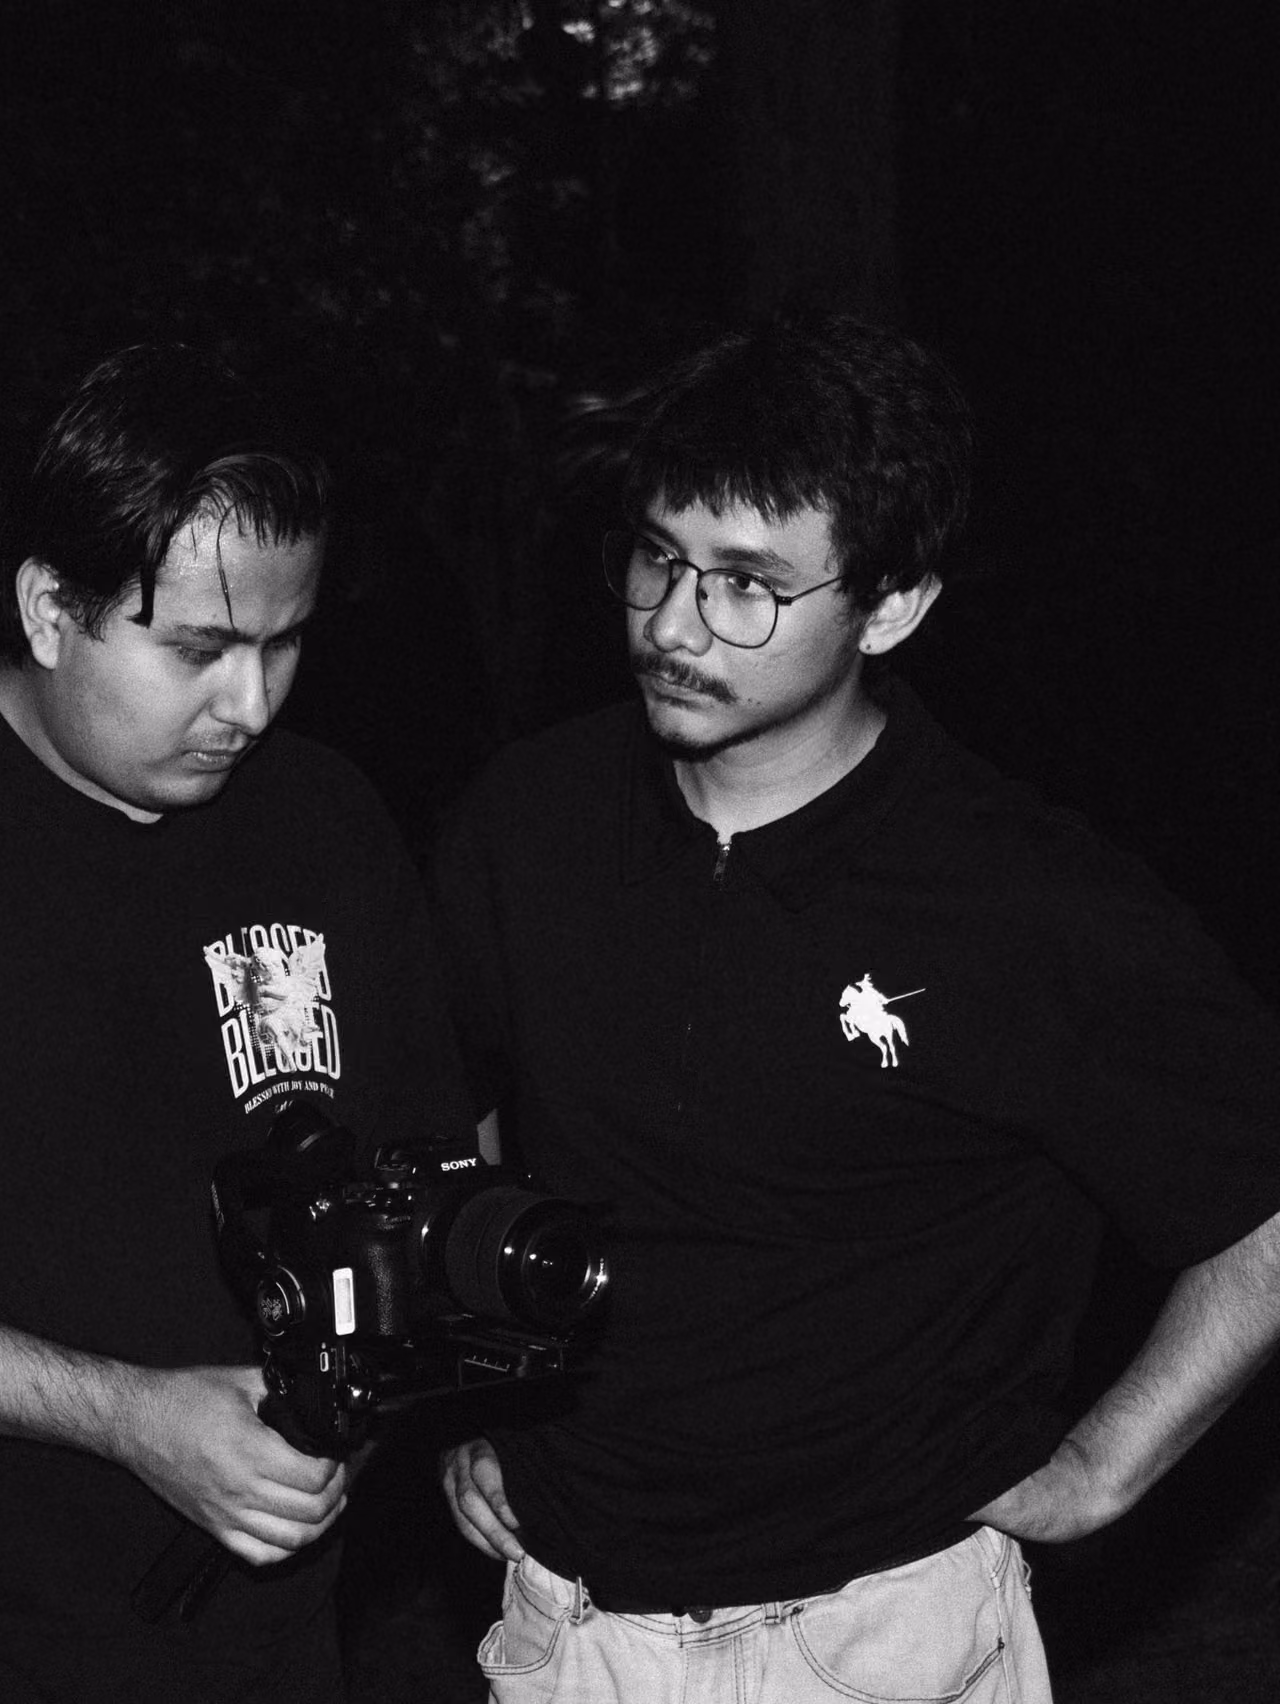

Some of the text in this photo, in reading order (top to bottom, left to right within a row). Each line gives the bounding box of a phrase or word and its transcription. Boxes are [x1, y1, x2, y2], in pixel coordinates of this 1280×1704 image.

[272, 1081, 290, 1094] WITH
[291, 1080, 303, 1091] JOY
[304, 1080, 319, 1091] AND
[441, 1158, 477, 1171] SONY
